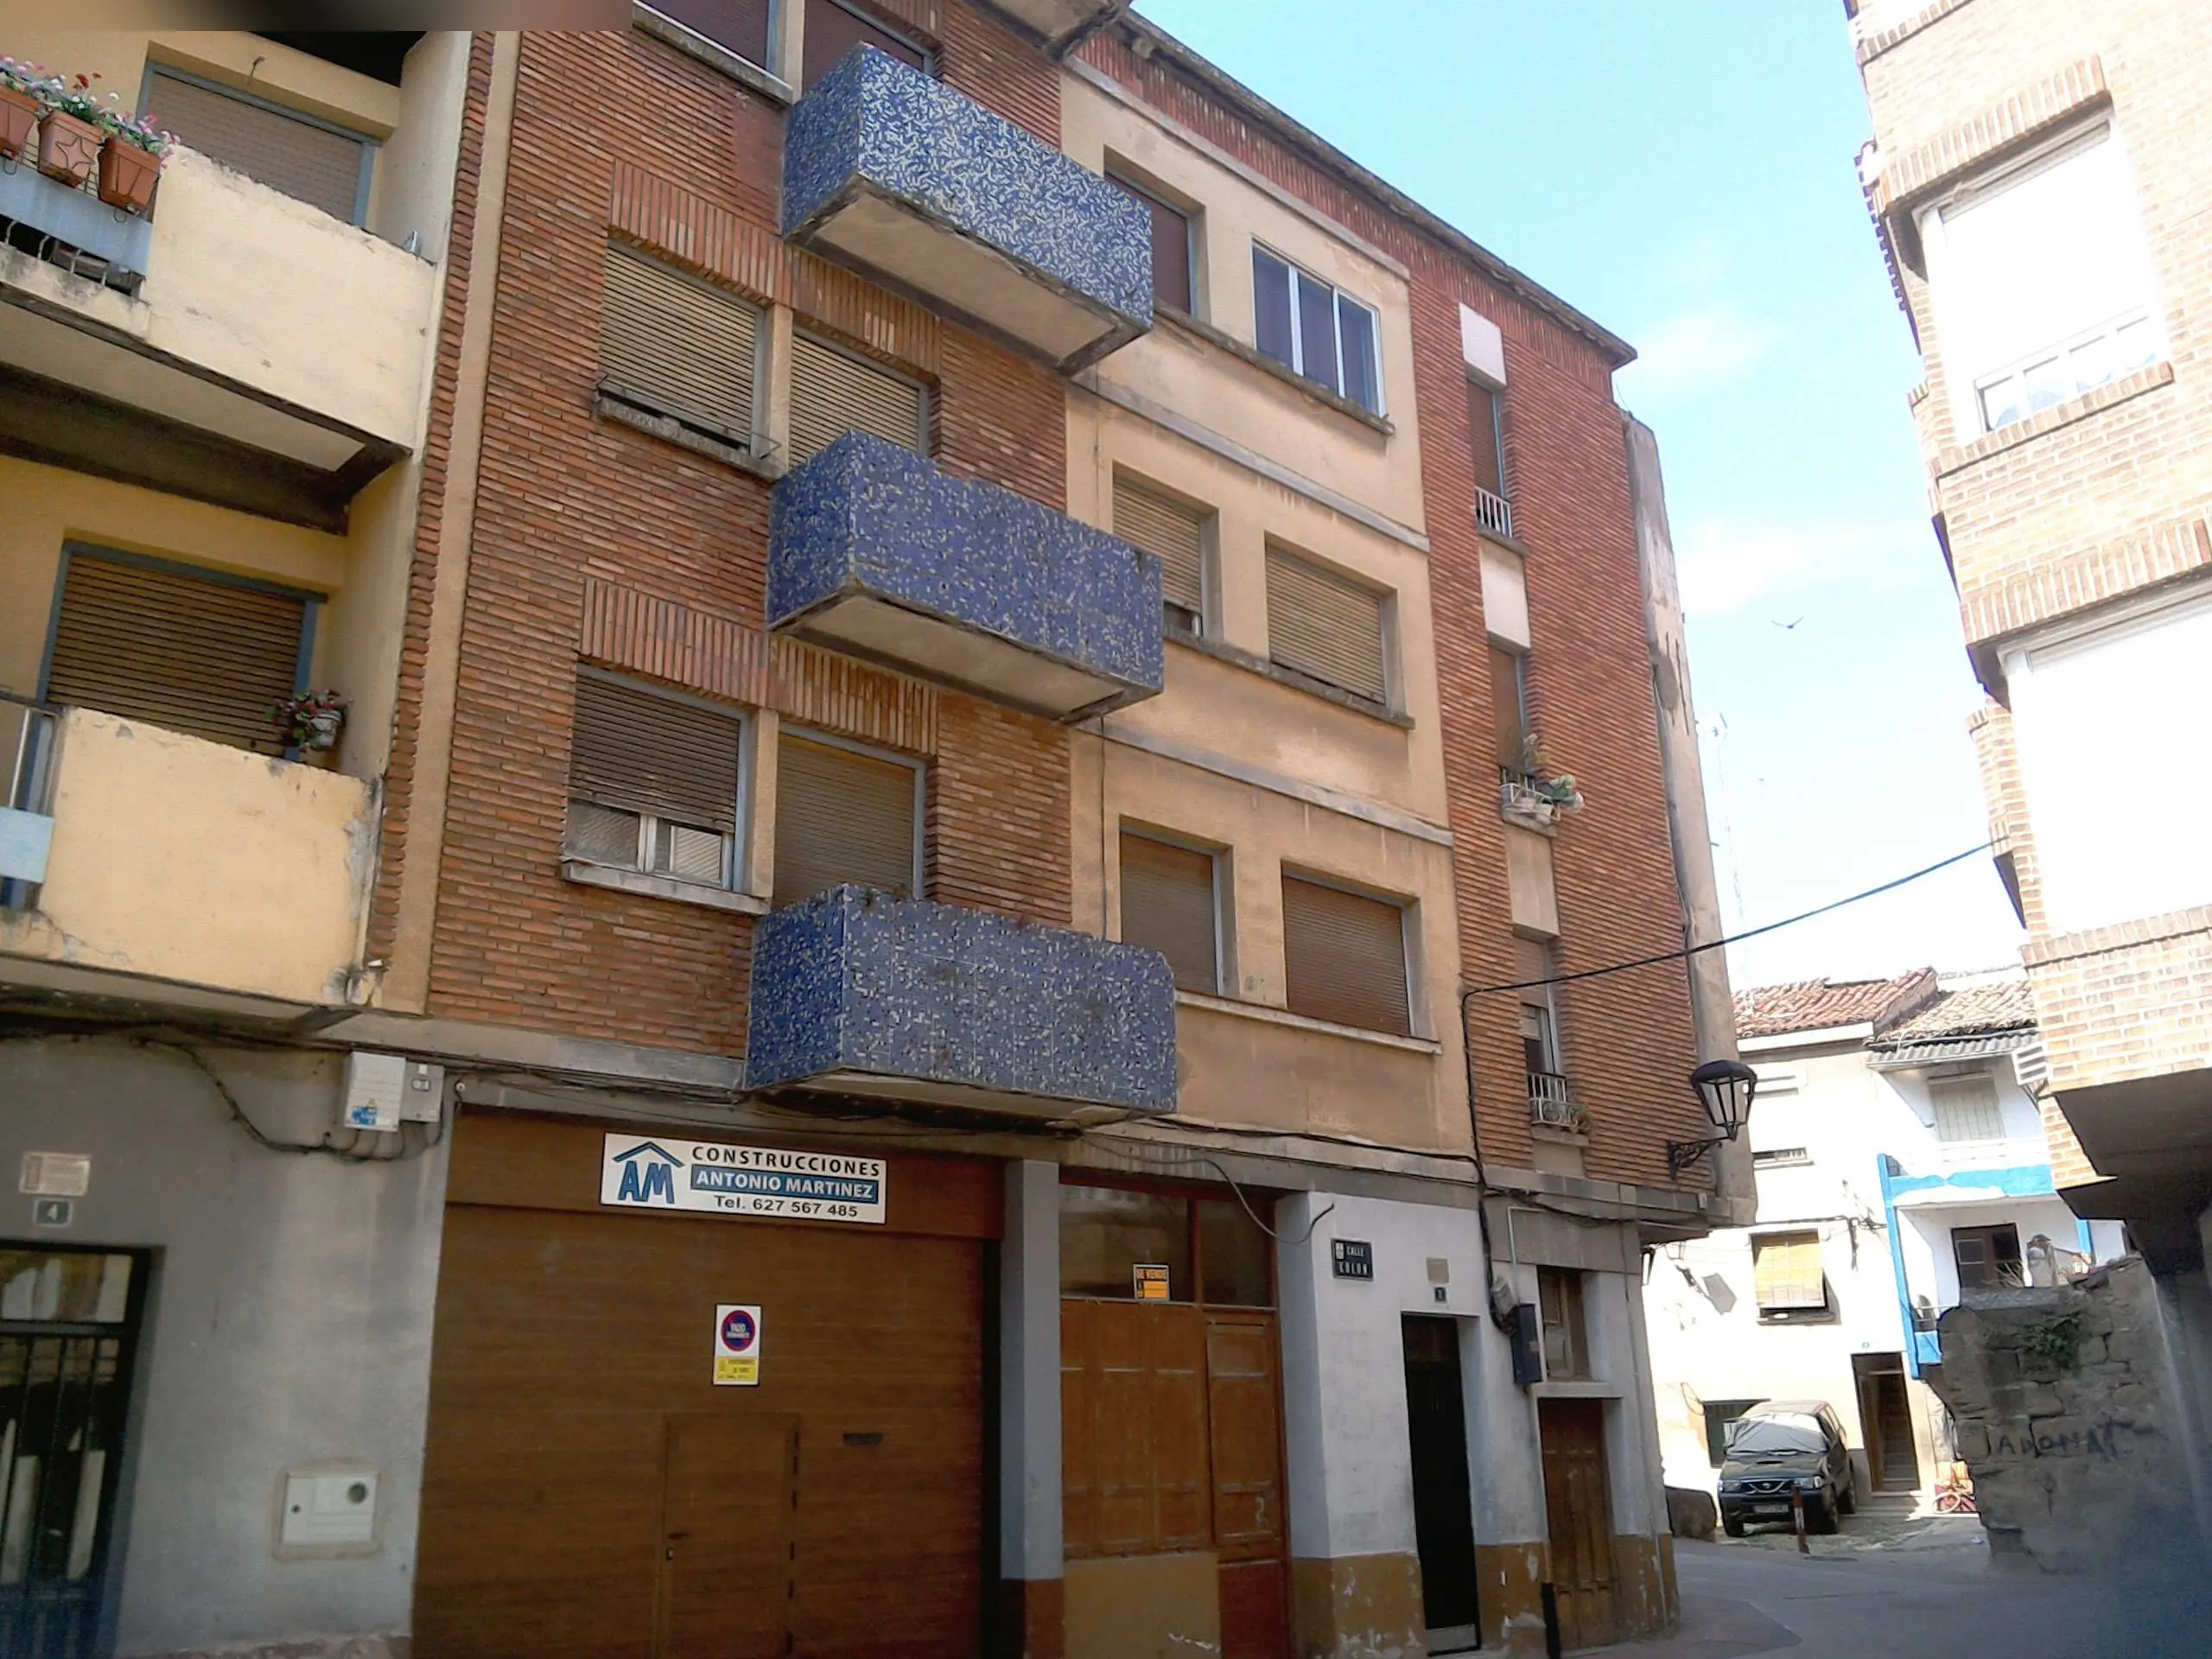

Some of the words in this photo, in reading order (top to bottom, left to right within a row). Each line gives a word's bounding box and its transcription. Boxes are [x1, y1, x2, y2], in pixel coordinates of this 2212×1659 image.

[691, 1145, 880, 1177] CONSTRUCCIONES
[618, 1160, 675, 1204] AM
[696, 1169, 781, 1191] ANTONIO
[785, 1177, 873, 1199] MARTINEZ
[714, 1194, 747, 1210] Tel.
[753, 1198, 785, 1211] 627
[791, 1201, 823, 1215] 567
[827, 1204, 858, 1217] 485
